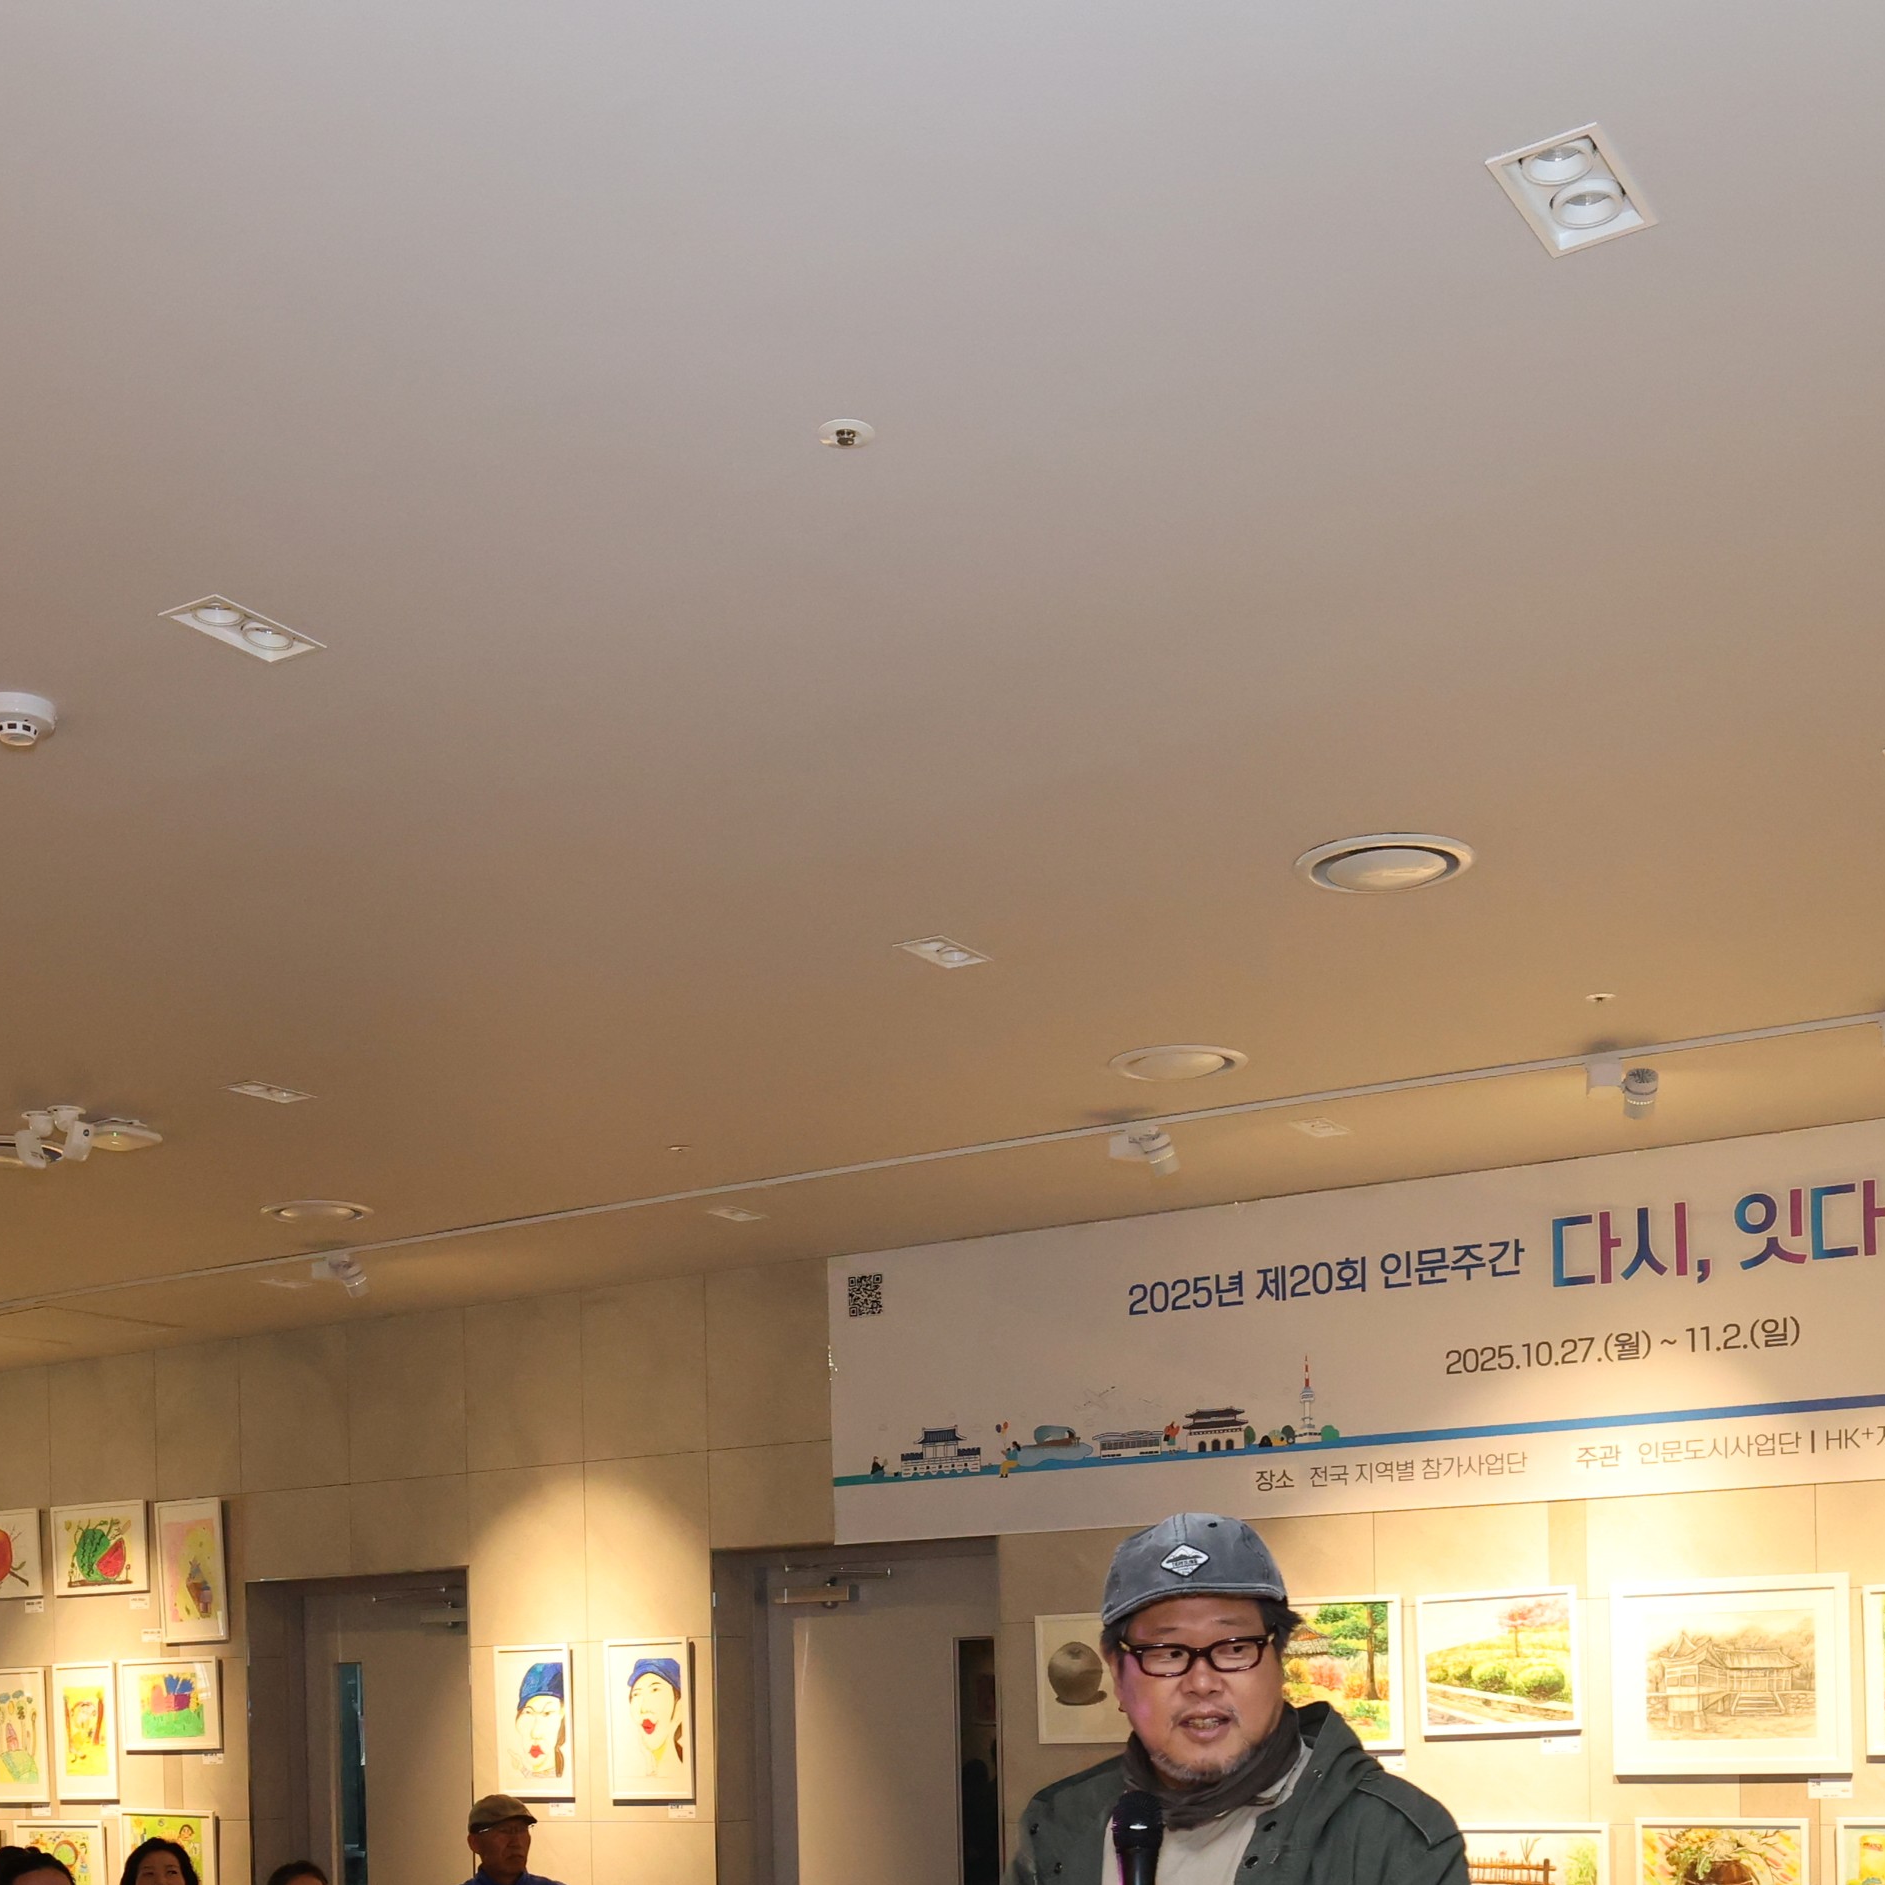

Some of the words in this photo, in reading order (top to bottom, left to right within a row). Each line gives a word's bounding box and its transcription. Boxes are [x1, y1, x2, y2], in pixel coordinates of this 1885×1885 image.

[1551, 1201, 1711, 1288] 다시,
[1128, 1270, 1244, 1316] 2025년
[1255, 1256, 1367, 1302] 제20회
[1380, 1238, 1526, 1290] 인문주간
[1445, 1329, 1652, 1375] 2025.10.27.(월)
[1685, 1313, 1800, 1353] 11.2.(일)
[1255, 1469, 1295, 1492] 장소
[1309, 1464, 1350, 1488] 전국
[1355, 1459, 1416, 1484] 지역별
[1421, 1451, 1528, 1480] 참가사업단
[1576, 1444, 1622, 1470] 주관
[1638, 1430, 1803, 1466] 인문도시사업단
